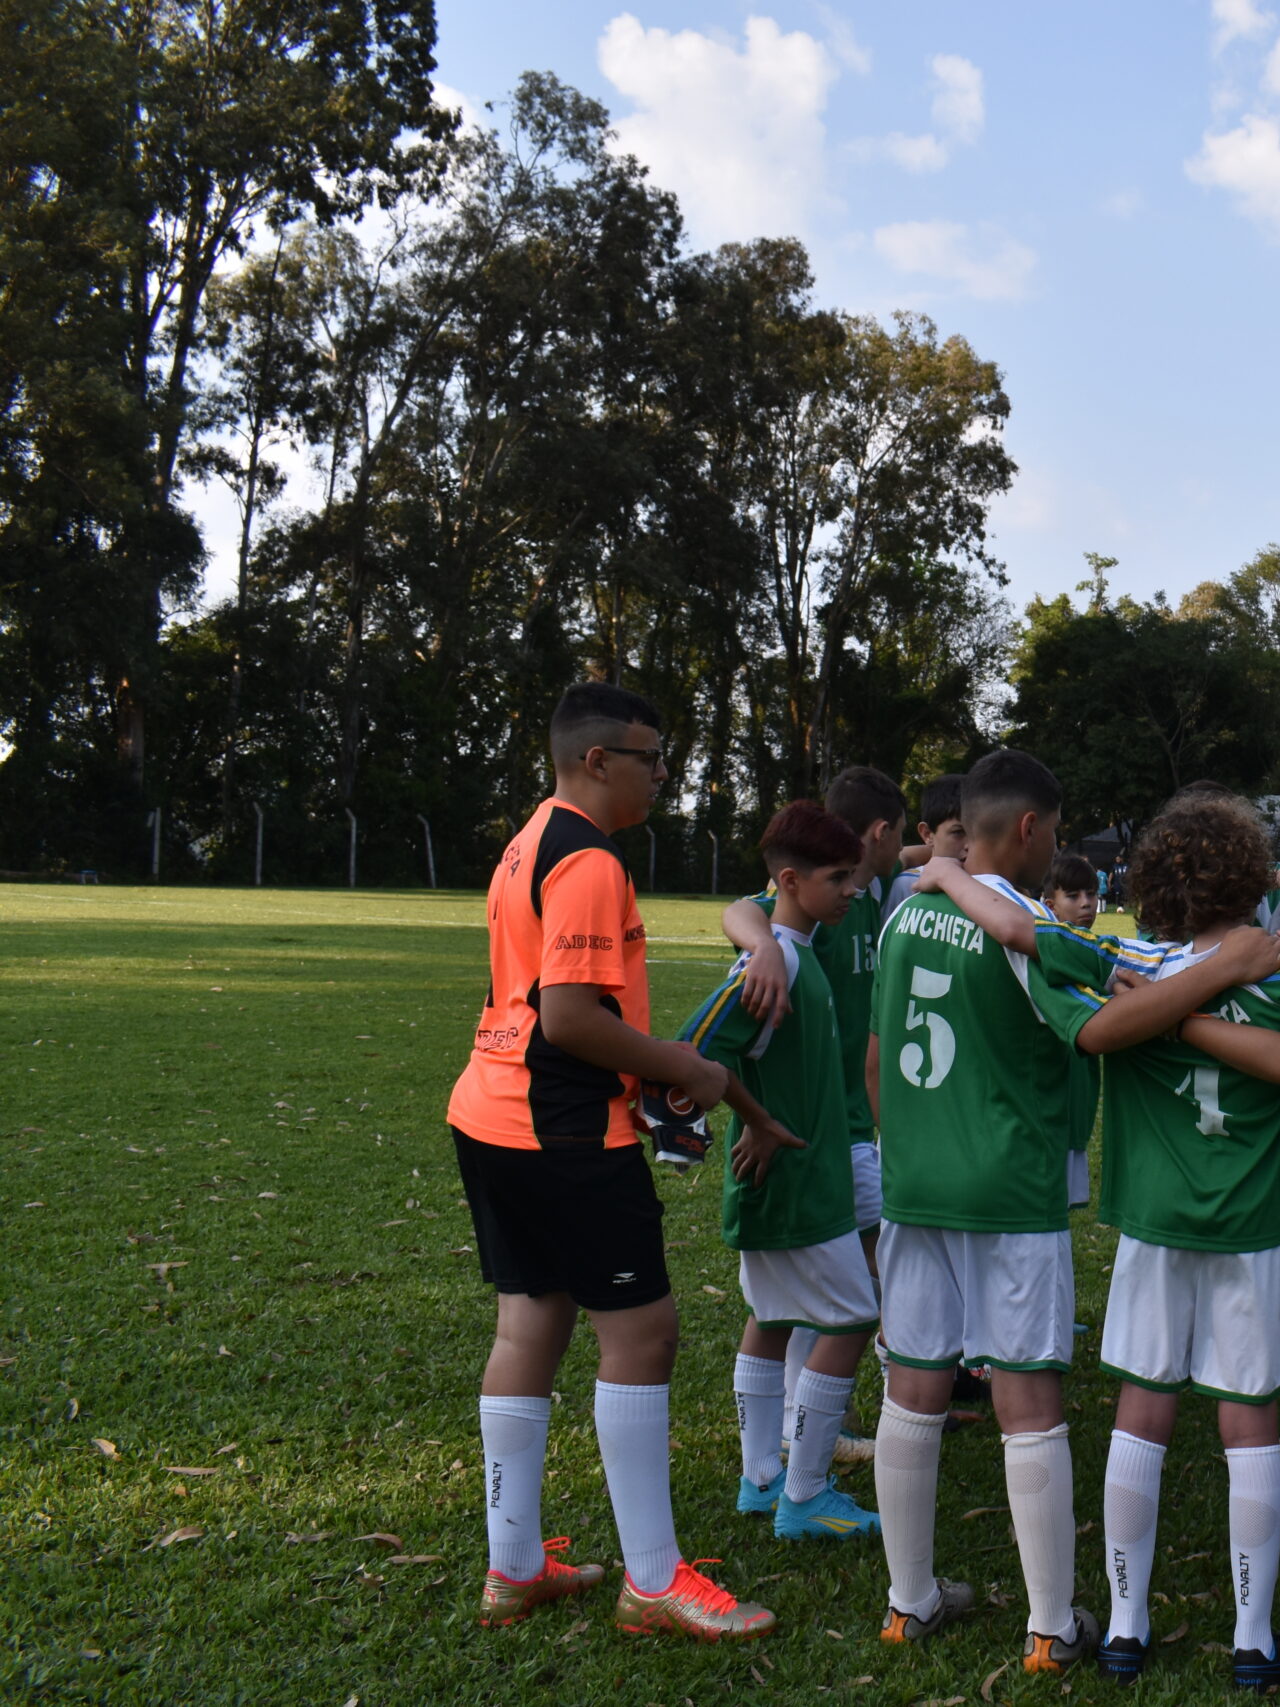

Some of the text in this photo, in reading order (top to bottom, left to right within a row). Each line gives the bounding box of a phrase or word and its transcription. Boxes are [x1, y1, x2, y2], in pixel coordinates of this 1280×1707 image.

[555, 934, 613, 951] ADEC
[895, 907, 984, 955] ANCHIETA
[900, 965, 956, 1089] 5
[490, 1461, 503, 1509] PENALTY
[1113, 1548, 1129, 1599] PENALTY
[1239, 1552, 1250, 1606] PENALTY
